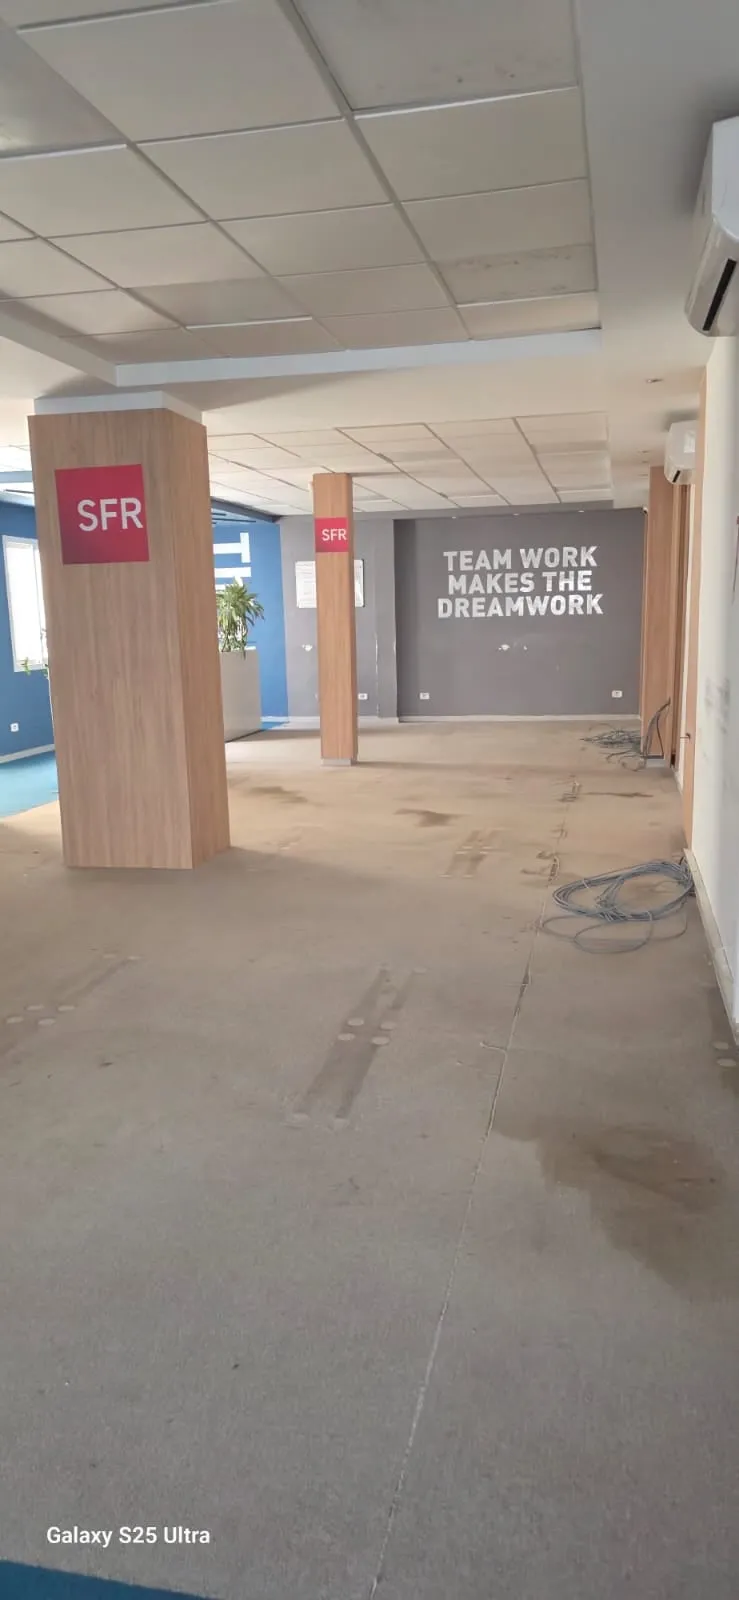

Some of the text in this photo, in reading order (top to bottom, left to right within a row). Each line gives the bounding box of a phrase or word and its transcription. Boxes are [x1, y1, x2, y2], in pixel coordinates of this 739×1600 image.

[77, 497, 144, 532] SFR
[321, 528, 347, 541] SFR
[443, 546, 598, 571] TEAM WORK
[448, 570, 593, 595] MAKES THE
[438, 593, 604, 618] DREAMWORK
